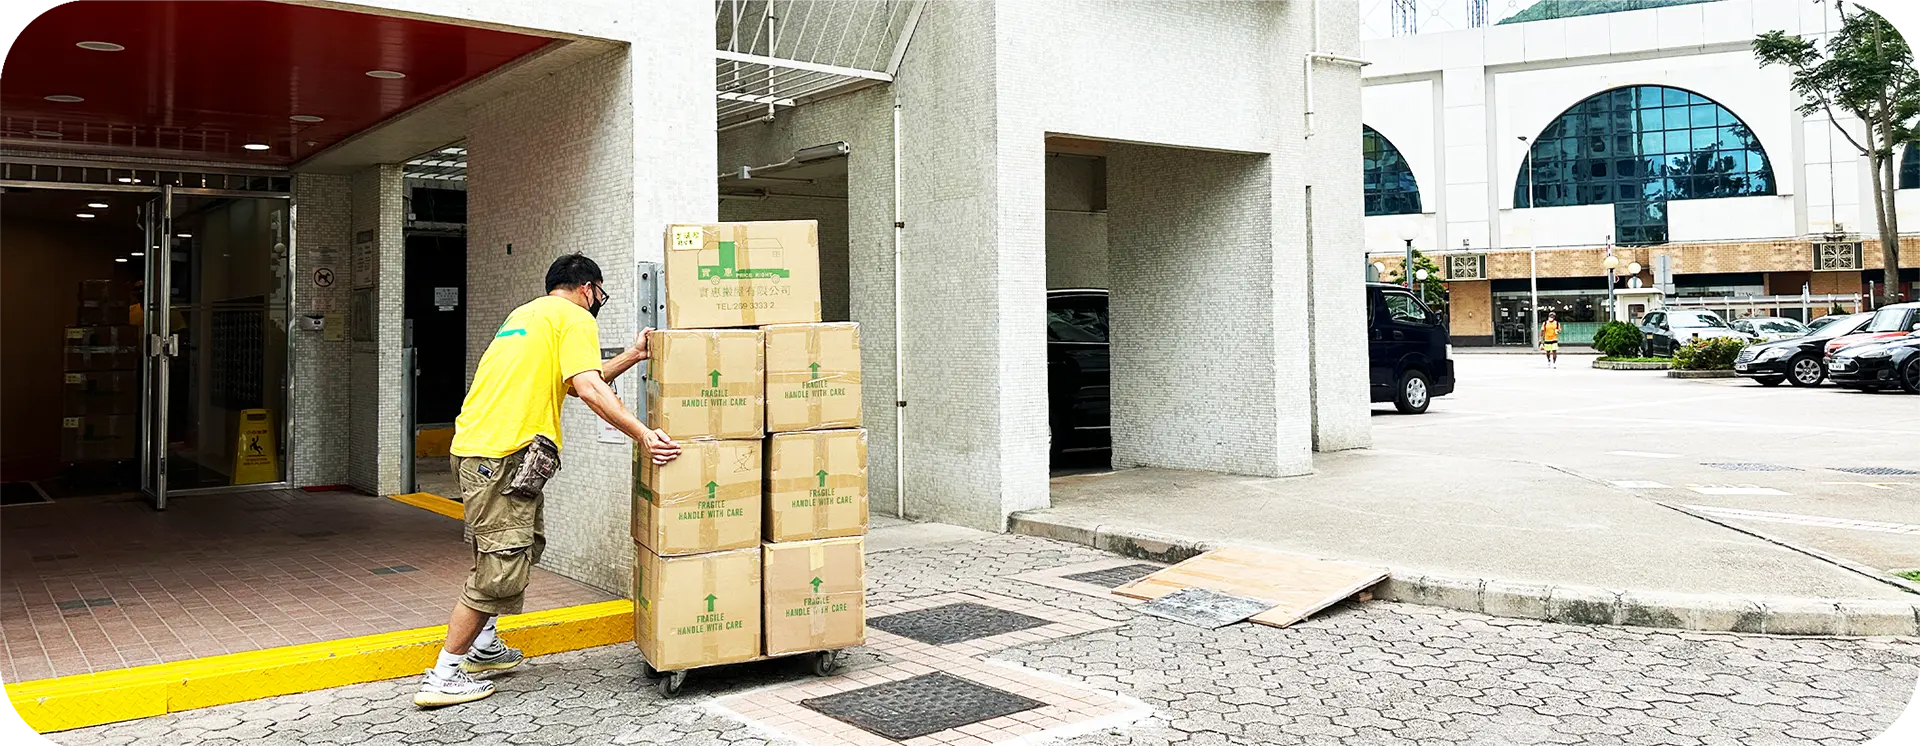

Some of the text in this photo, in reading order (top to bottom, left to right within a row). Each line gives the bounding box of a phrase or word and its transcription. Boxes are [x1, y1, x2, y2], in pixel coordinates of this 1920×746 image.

[801, 380, 828, 389] FRAGILE
[701, 389, 728, 397] FRAGILE
[784, 388, 846, 399] HANDLE WITH CARE
[682, 398, 747, 407] HANDLE WITH CARE
[809, 488, 835, 497] FRAGILE
[698, 500, 725, 509] FRAGILE
[791, 496, 853, 508] HANDLE WITH CARE
[678, 508, 743, 520] HANDLE WITH CARE
[785, 606, 811, 617] HANDLE
[831, 603, 847, 612] CARE
[696, 612, 725, 623] FRAGILE
[677, 620, 743, 635] HANDLE WITH CARE
